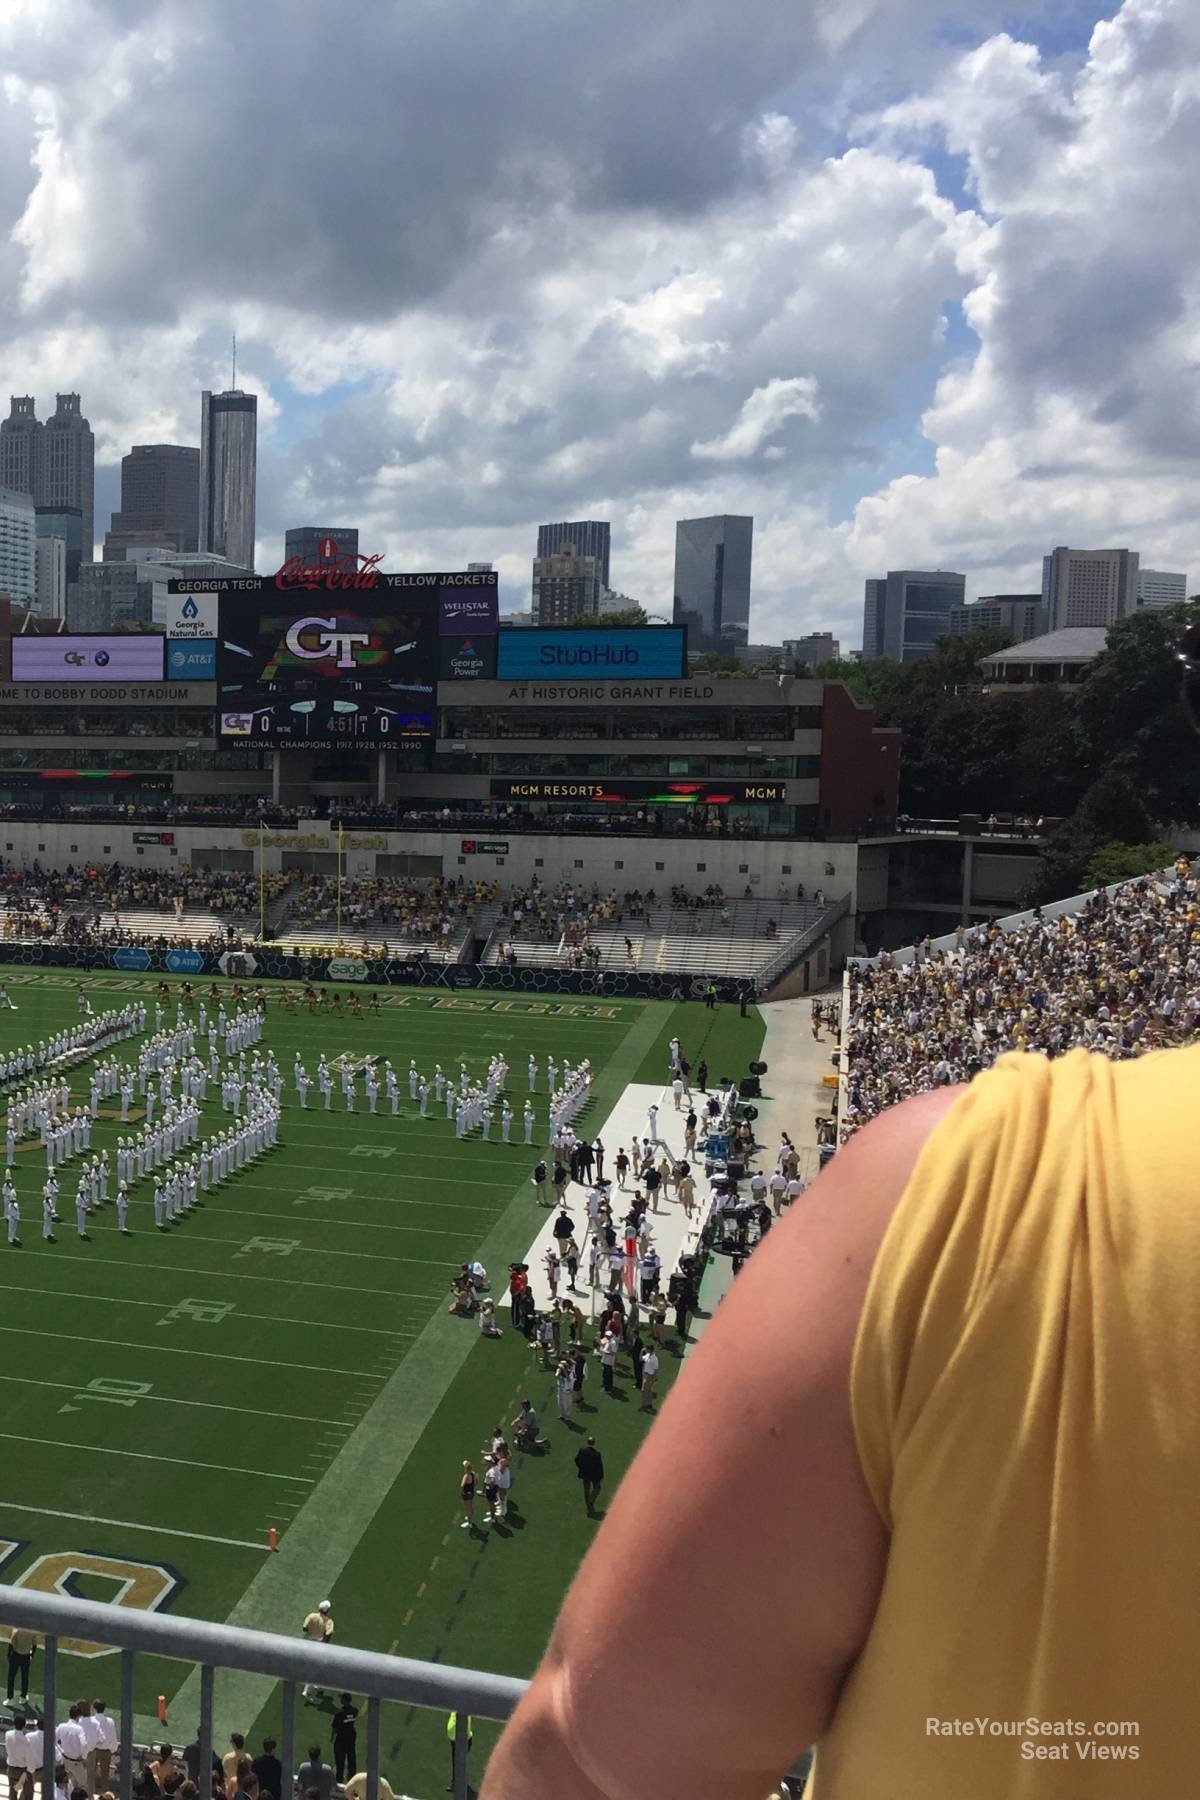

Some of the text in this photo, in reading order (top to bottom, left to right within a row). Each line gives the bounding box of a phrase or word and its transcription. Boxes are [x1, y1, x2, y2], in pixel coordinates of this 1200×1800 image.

[178, 580, 262, 591] GEORGIA TECH
[387, 574, 496, 587] YELLOW JACKETS
[444, 602, 489, 610] WELLSTAR
[175, 621, 205, 630] Georgia
[170, 629, 214, 637] Natural Gas
[285, 617, 369, 668] GT
[188, 654, 213, 664] AT&T
[540, 645, 640, 665] StubHub
[451, 659, 484, 669] Georgia
[455, 668, 480, 676] Power
[24, 689, 40, 700] TO
[44, 689, 86, 699] BOBBY
[91, 689, 127, 699] DODD
[132, 688, 188, 699] STADIUM
[509, 687, 714, 698] AT HISTORIC GRANT FIELD
[261, 716, 270, 732] 0
[327, 716, 352, 732] 4:51
[380, 716, 389, 732] 0
[233, 741, 274, 749] NATIONAL
[280, 741, 331, 749] CHAMPIONS
[401, 742, 422, 750] 1990
[510, 785, 603, 796] MGM RESORTS
[745, 787, 777, 798] MGM
[241, 831, 388, 850] Georgia Tech
[331, 962, 367, 979] sage
[384, 995, 623, 1018] TECH
[239, 1236, 301, 1256] 30
[166, 1299, 237, 1323] 20
[73, 1377, 154, 1407] 10
